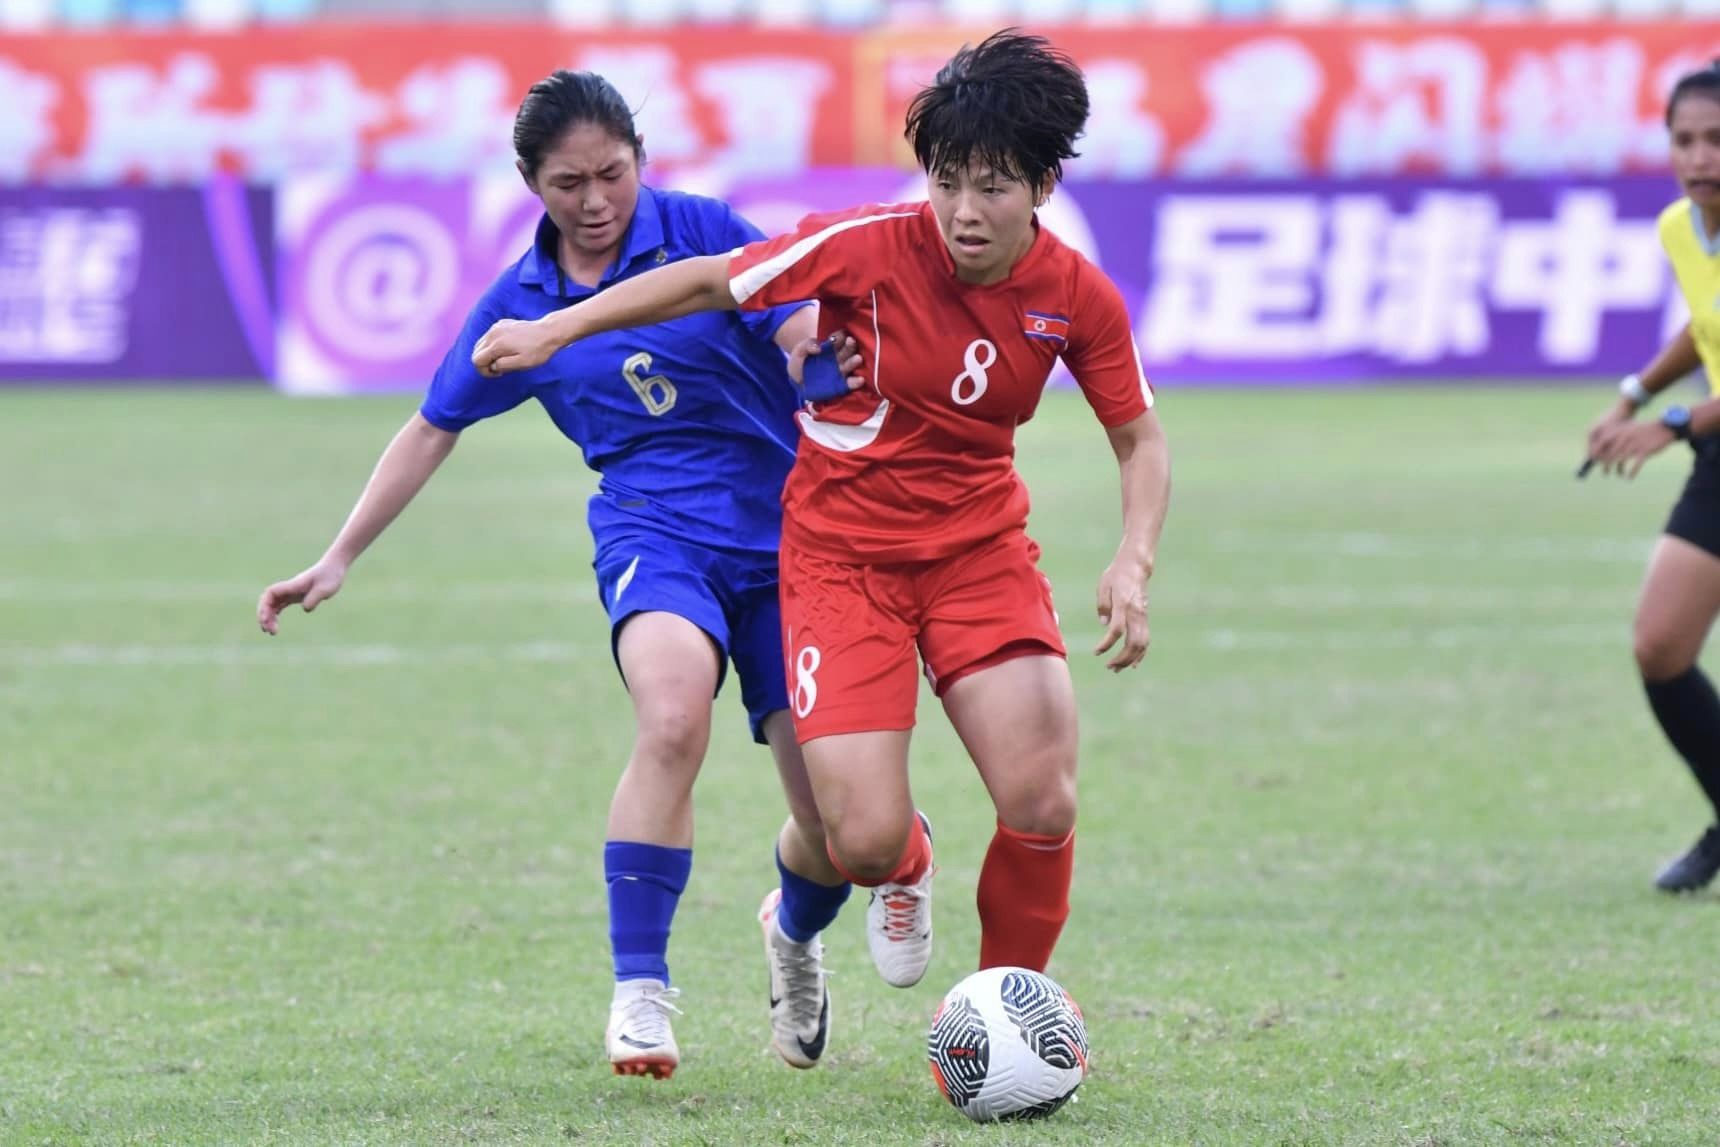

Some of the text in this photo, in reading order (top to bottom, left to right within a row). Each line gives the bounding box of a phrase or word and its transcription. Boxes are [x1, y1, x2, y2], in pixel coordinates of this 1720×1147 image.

[1141, 190, 1690, 364] 足球中
[622, 351, 678, 417] 6
[951, 338, 998, 405] 8
[795, 645, 821, 719] 8
